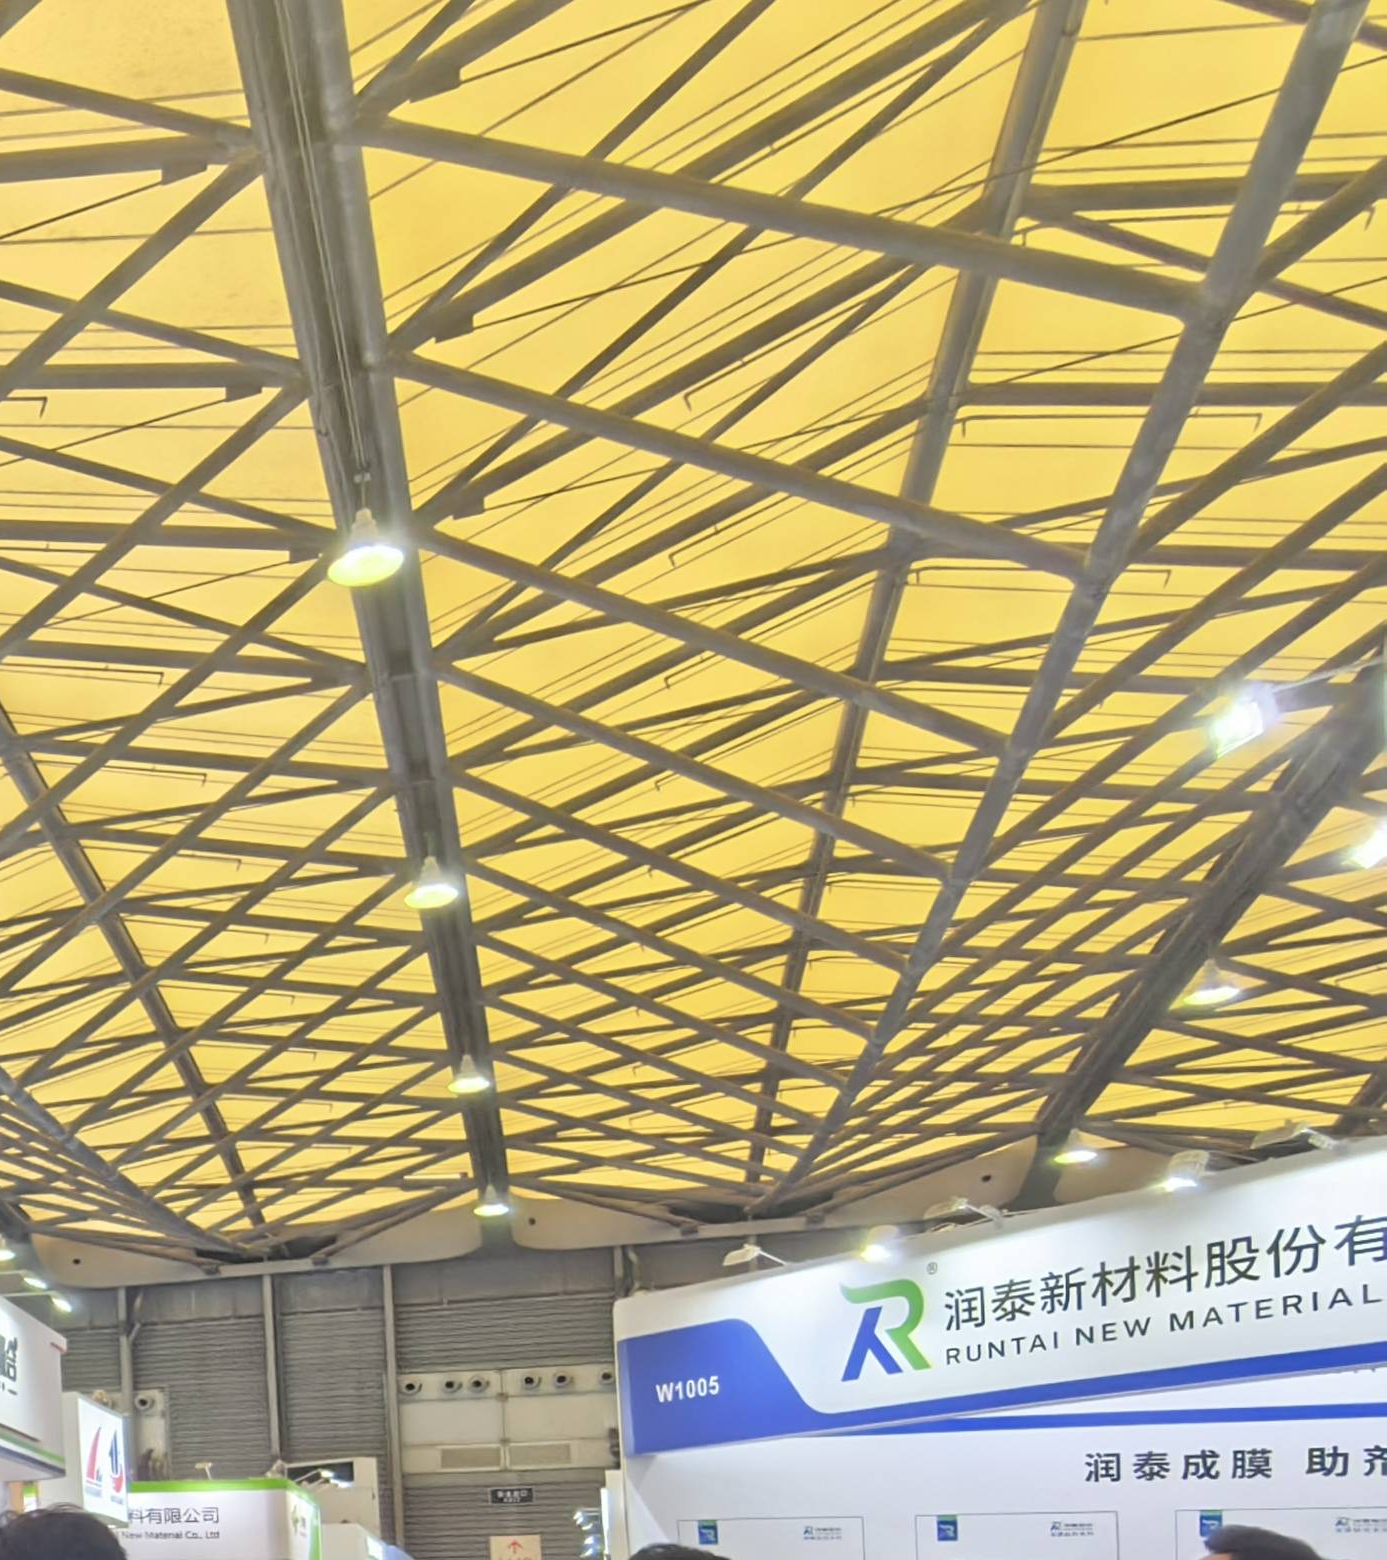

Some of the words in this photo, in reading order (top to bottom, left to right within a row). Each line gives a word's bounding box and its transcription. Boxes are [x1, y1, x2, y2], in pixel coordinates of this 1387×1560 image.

[944, 1213, 1387, 1333] 润泰新材料股份有
[945, 1332, 1059, 1366] RUNTAI
[1075, 1316, 1151, 1347] NEW
[1169, 1283, 1384, 1331] MATERIAL
[655, 1376, 720, 1404] W1005
[1084, 1448, 1273, 1483] 润泰成膜
